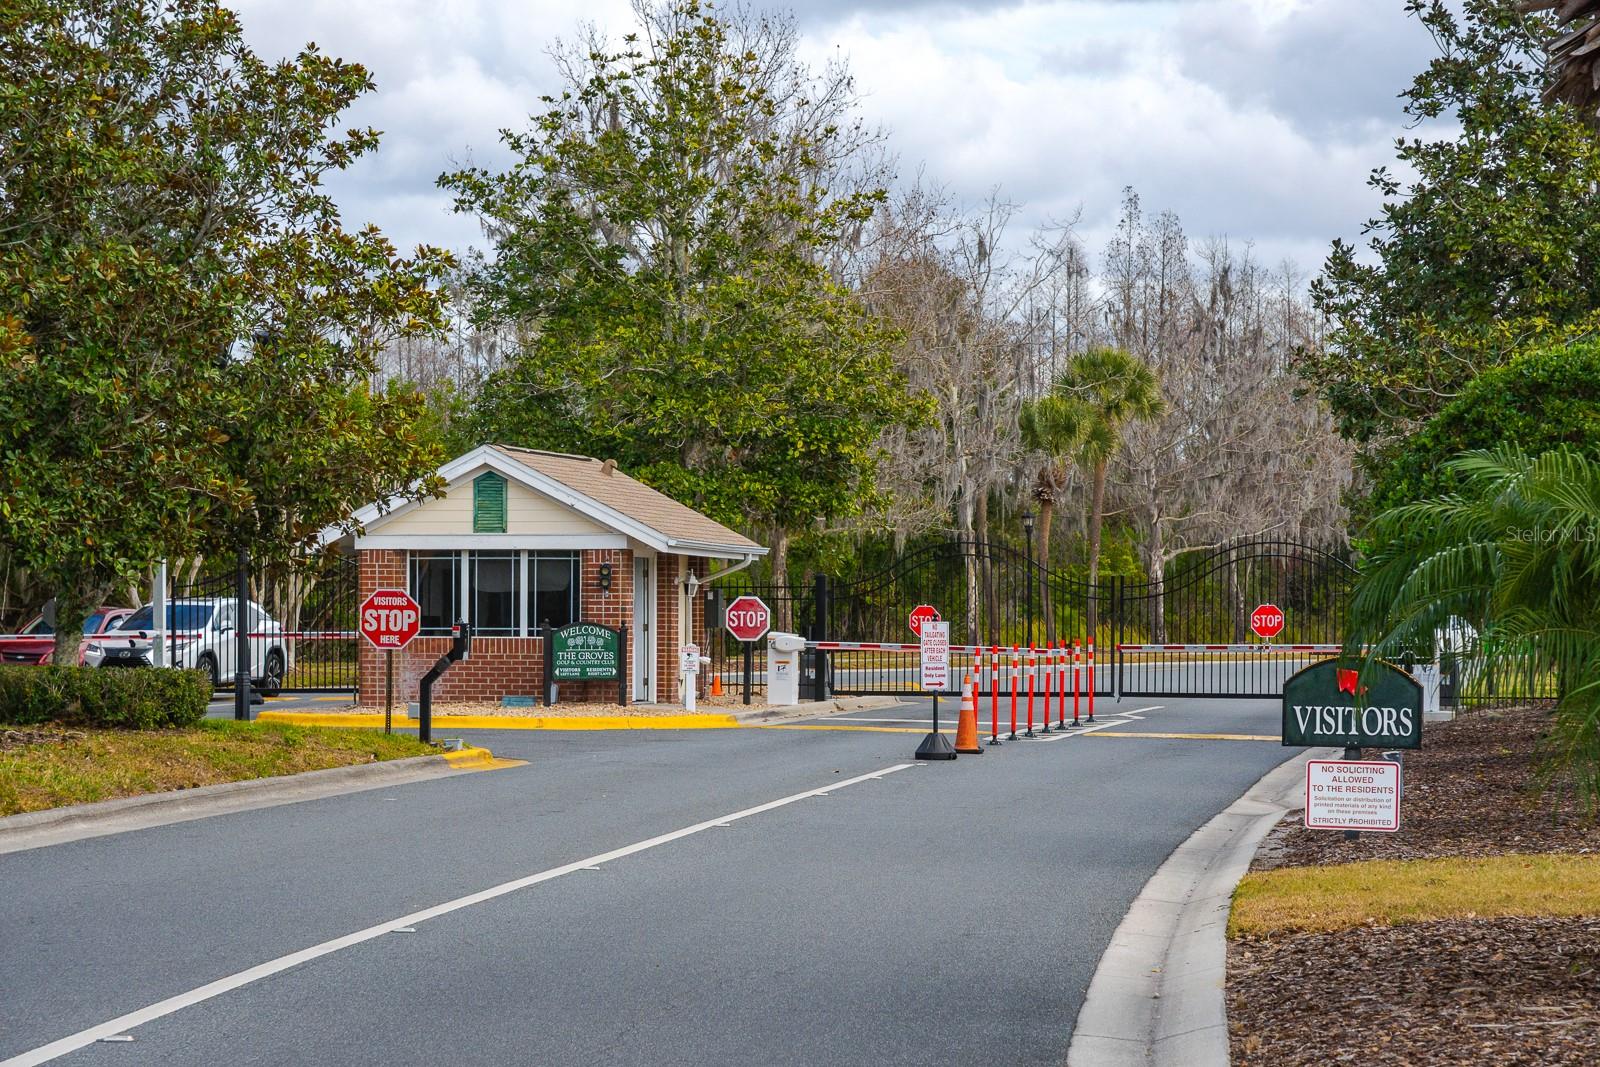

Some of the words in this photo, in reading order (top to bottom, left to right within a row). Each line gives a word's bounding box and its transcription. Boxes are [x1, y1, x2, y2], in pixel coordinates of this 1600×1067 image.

[374, 596, 408, 606] VISITORS
[364, 609, 416, 632] STOP
[728, 610, 766, 628] STOP
[912, 616, 936, 627] STO
[1254, 615, 1282, 627] STOP
[560, 626, 611, 640] WELCOME
[380, 634, 400, 644] HERE
[557, 652, 576, 660] THE
[578, 652, 614, 660] GROVES
[1293, 705, 1413, 736] VISITORS
[1336, 766, 1385, 774] SOLICITING
[1346, 786, 1394, 794] RESIDENTS
[1348, 818, 1392, 826] PROHIBITED
